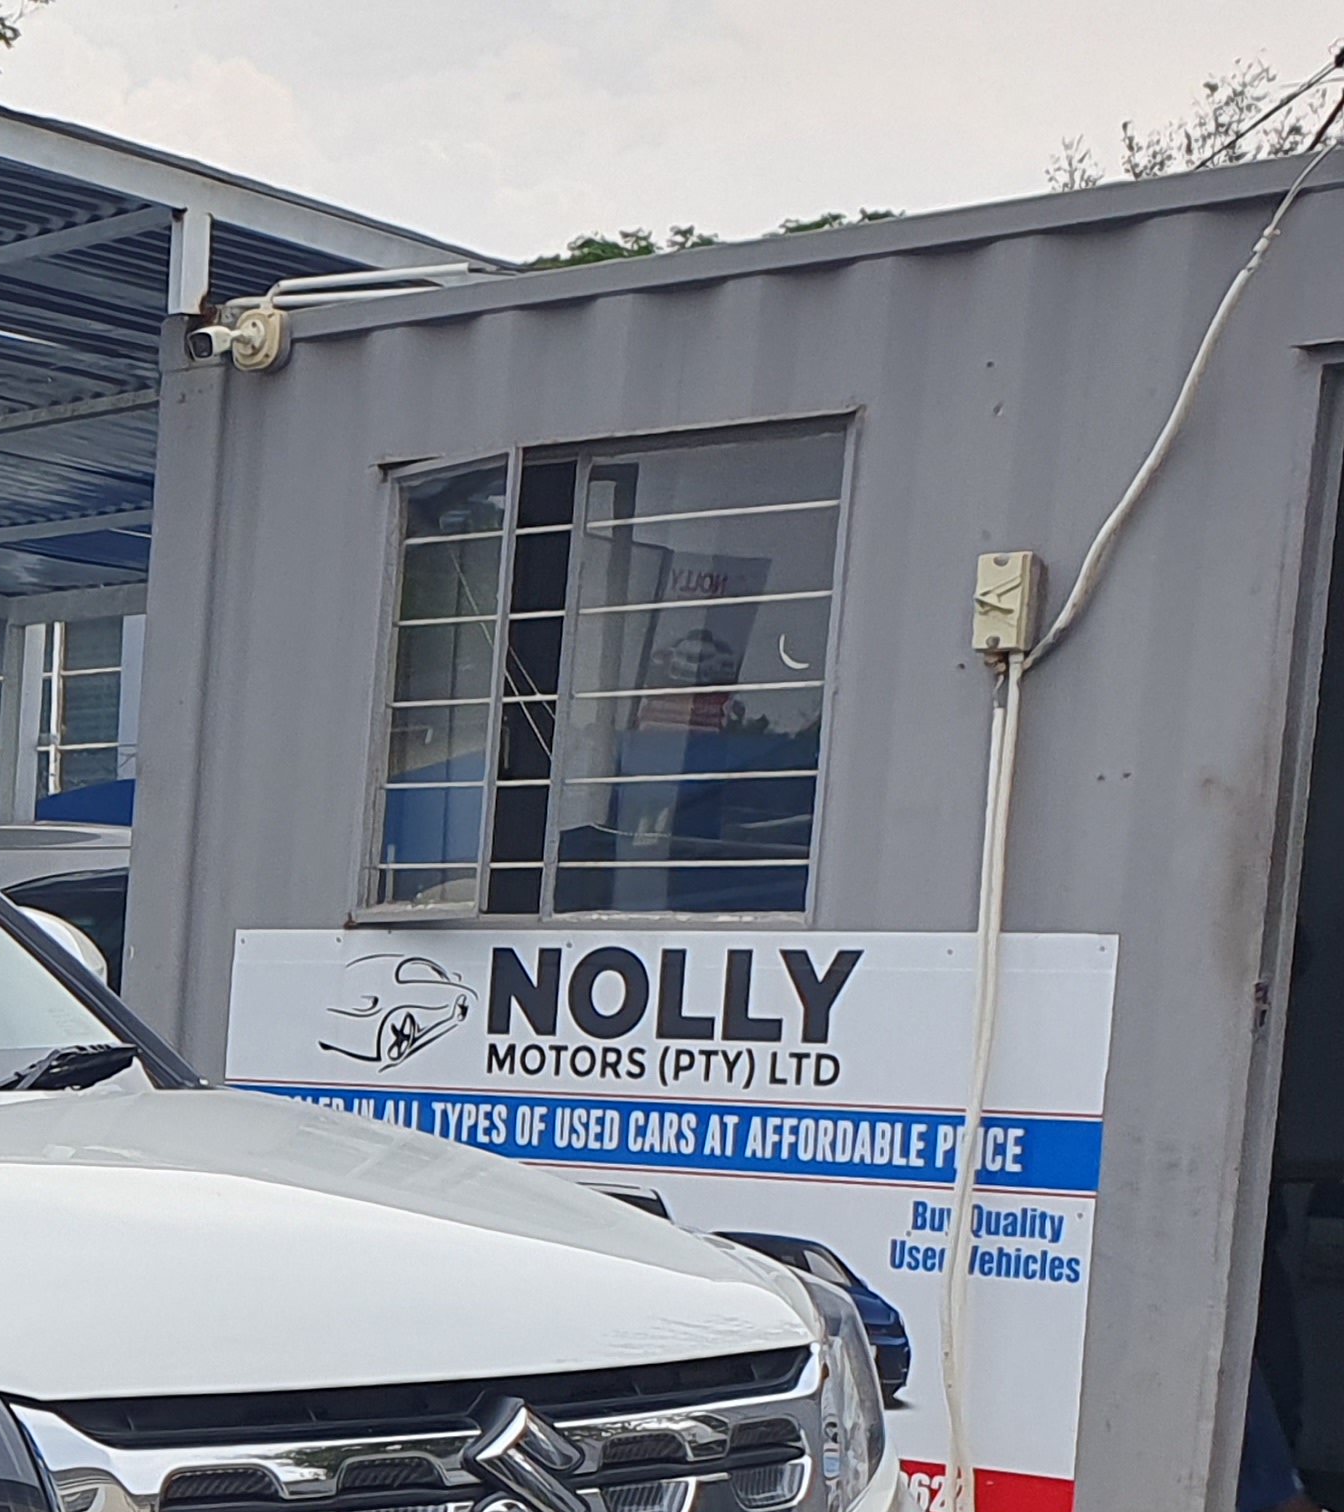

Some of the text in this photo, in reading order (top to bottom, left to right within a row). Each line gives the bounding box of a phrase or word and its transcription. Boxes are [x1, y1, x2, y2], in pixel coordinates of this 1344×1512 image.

[487, 946, 864, 1044] NOLLY
[486, 1044, 841, 1089] MOTORS (PTY) LTD
[431, 1101, 508, 1144] TYPES
[515, 1105, 546, 1146] OF
[554, 1106, 619, 1151] USED
[627, 1111, 697, 1155] CARS
[703, 1114, 740, 1156] AT
[744, 1116, 928, 1167] AFFORDABLE
[971, 1203, 1064, 1243] Quality
